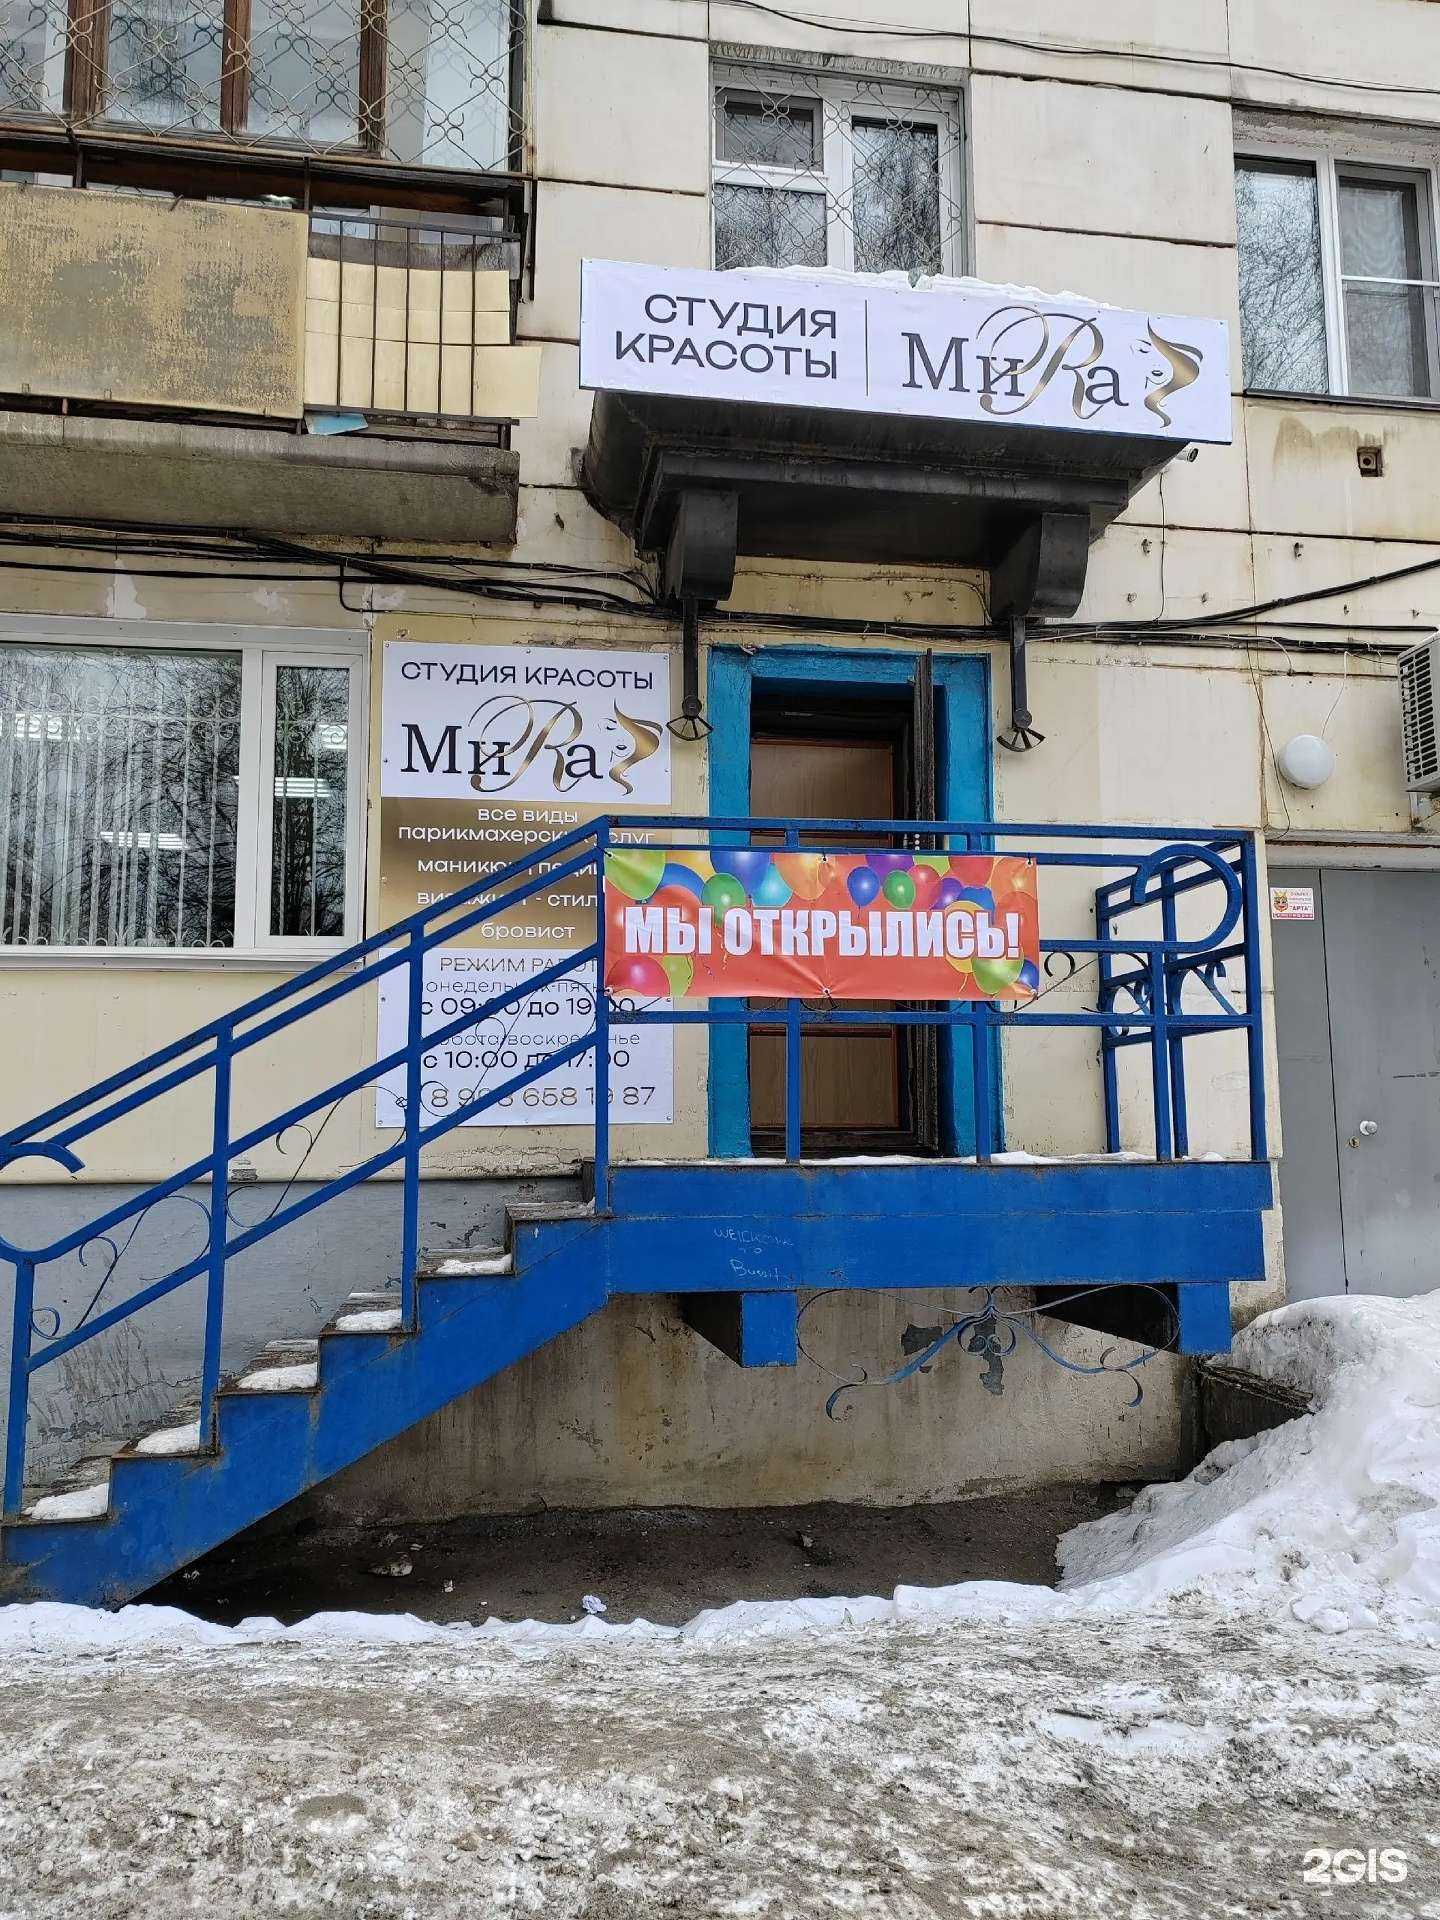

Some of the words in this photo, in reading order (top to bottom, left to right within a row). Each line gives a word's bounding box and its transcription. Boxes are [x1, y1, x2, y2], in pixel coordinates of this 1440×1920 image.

[645, 294, 837, 339] СТУДИЯ
[616, 331, 837, 379] КРАСОТЫ
[401, 662, 516, 685] СТУДИЯ
[525, 667, 654, 690] КРАСОТЫ
[477, 808, 517, 822] все
[523, 809, 578, 825] виды
[398, 826, 589, 846] парикмахерск
[480, 922, 576, 942] бровист
[624, 906, 712, 955] МЫ
[724, 907, 1021, 959] ОТКРЫЛИСЬ!
[440, 957, 525, 973] РЕЖИМ
[441, 997, 521, 1016] 09:0
[527, 1001, 560, 1018] до
[424, 1054, 438, 1069] с
[444, 1050, 518, 1069] 10:00
[431, 1088, 449, 1108] 8
[522, 1087, 578, 1107] 658
[622, 1087, 656, 1106] 87
